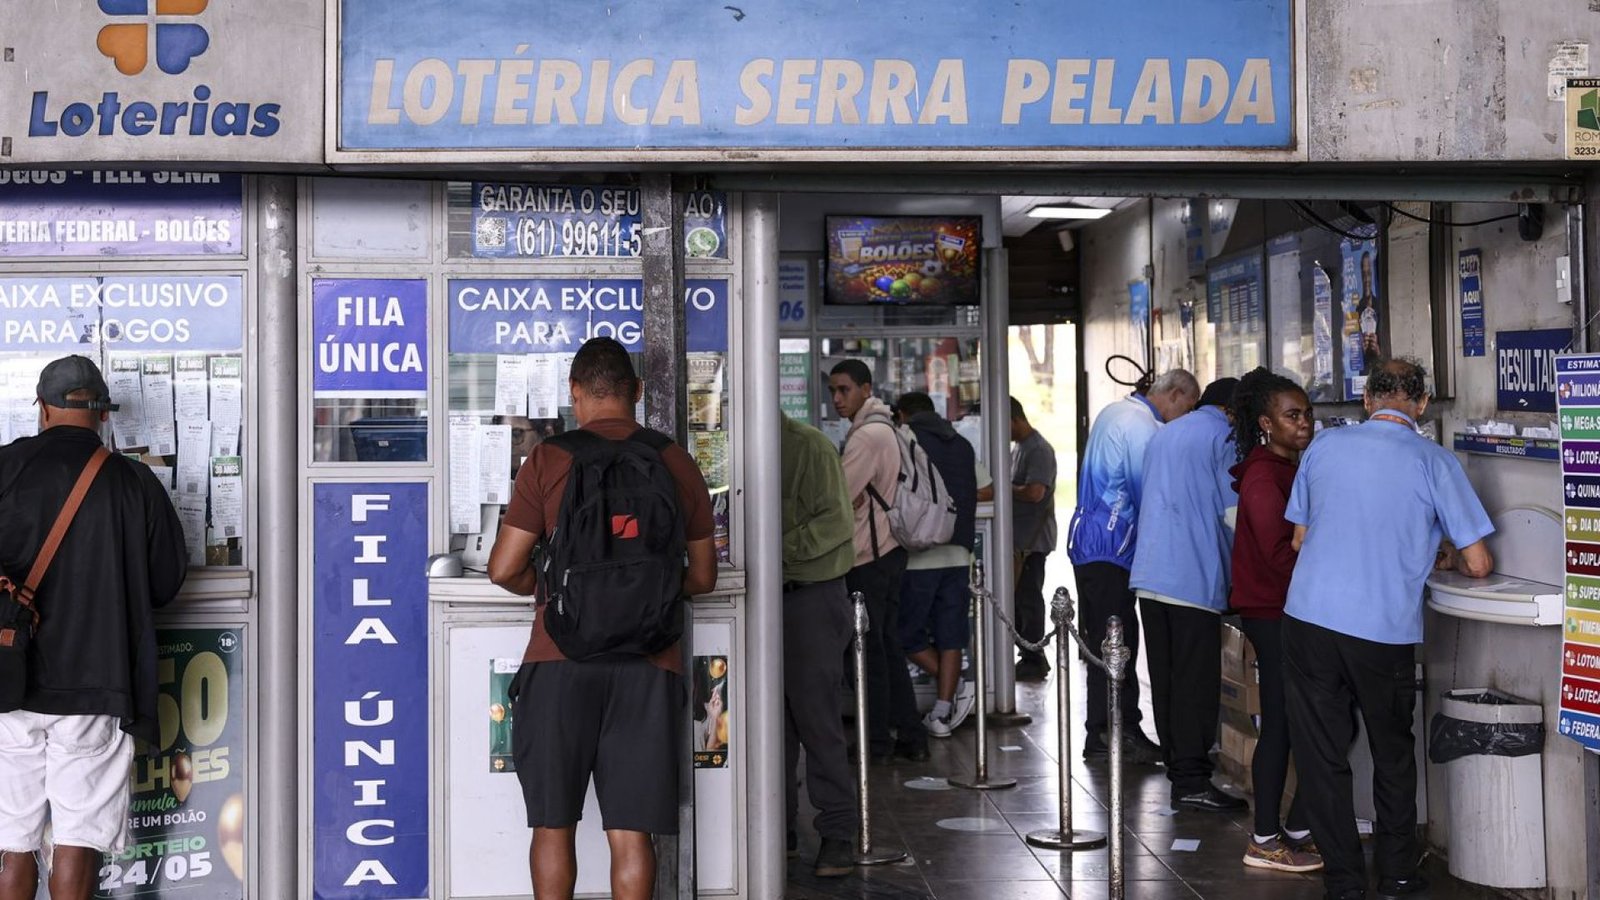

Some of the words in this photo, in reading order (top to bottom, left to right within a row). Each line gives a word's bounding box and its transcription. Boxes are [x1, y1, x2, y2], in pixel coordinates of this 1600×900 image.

[367, 44, 700, 125] LOTÉRICA
[735, 58, 968, 125] SERRA
[1001, 58, 1275, 125] PELADA
[28, 85, 281, 137] Loterias
[480, 186, 575, 213] GARANTA
[581, 190, 594, 214] O
[601, 190, 640, 215] SEU
[55, 220, 138, 242] FEDERAL
[155, 216, 230, 242] BOLÕES
[517, 218, 555, 256] (61)
[562, 220, 641, 257] 99611-5
[70, 283, 228, 307] EXCLUSIVO
[458, 287, 551, 310] CAIXA
[561, 287, 715, 311] EXCLUO
[338, 297, 404, 326] FILA
[6, 319, 78, 343] PARA
[91, 318, 190, 343] JOGOS
[496, 321, 570, 344] PARA
[579, 321, 645, 344] JOG
[319, 338, 423, 373] ÚNICA
[1499, 348, 1574, 392] RESULTAD
[345, 494, 398, 644] FILA
[1571, 721, 1600, 740] FEDERA
[343, 691, 398, 886] ÚNICA
[142, 816, 161, 827] UM
[164, 809, 206, 825] BOLÃO
[98, 852, 212, 890] 24/05
